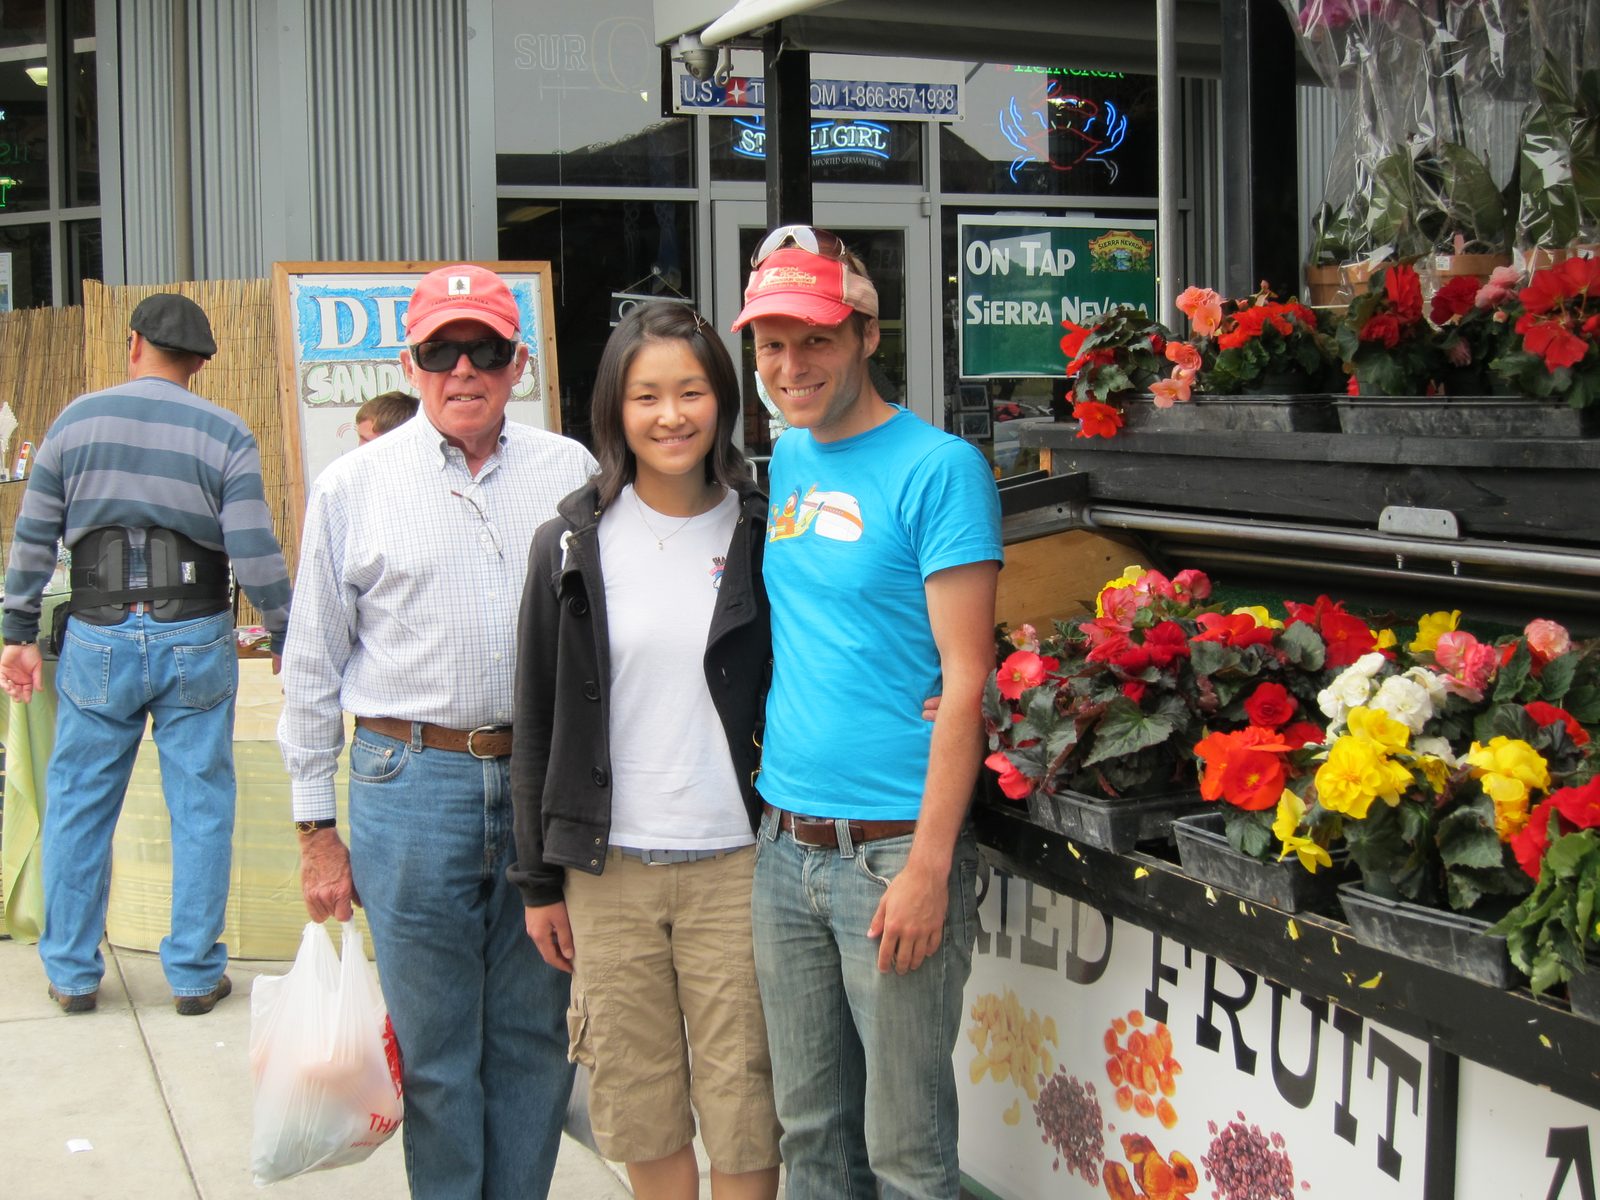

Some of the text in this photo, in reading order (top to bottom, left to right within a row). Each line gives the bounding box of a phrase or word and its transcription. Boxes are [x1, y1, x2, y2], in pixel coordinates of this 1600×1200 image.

[842, 86, 954, 111] 1-866-857-1938
[833, 125, 887, 150] GIRL
[811, 156, 841, 167] MPORTED
[1098, 240, 1143, 251] SIERRA NEVADA
[966, 240, 1076, 277] ON TAP
[1145, 930, 1422, 1182] FRUIT
